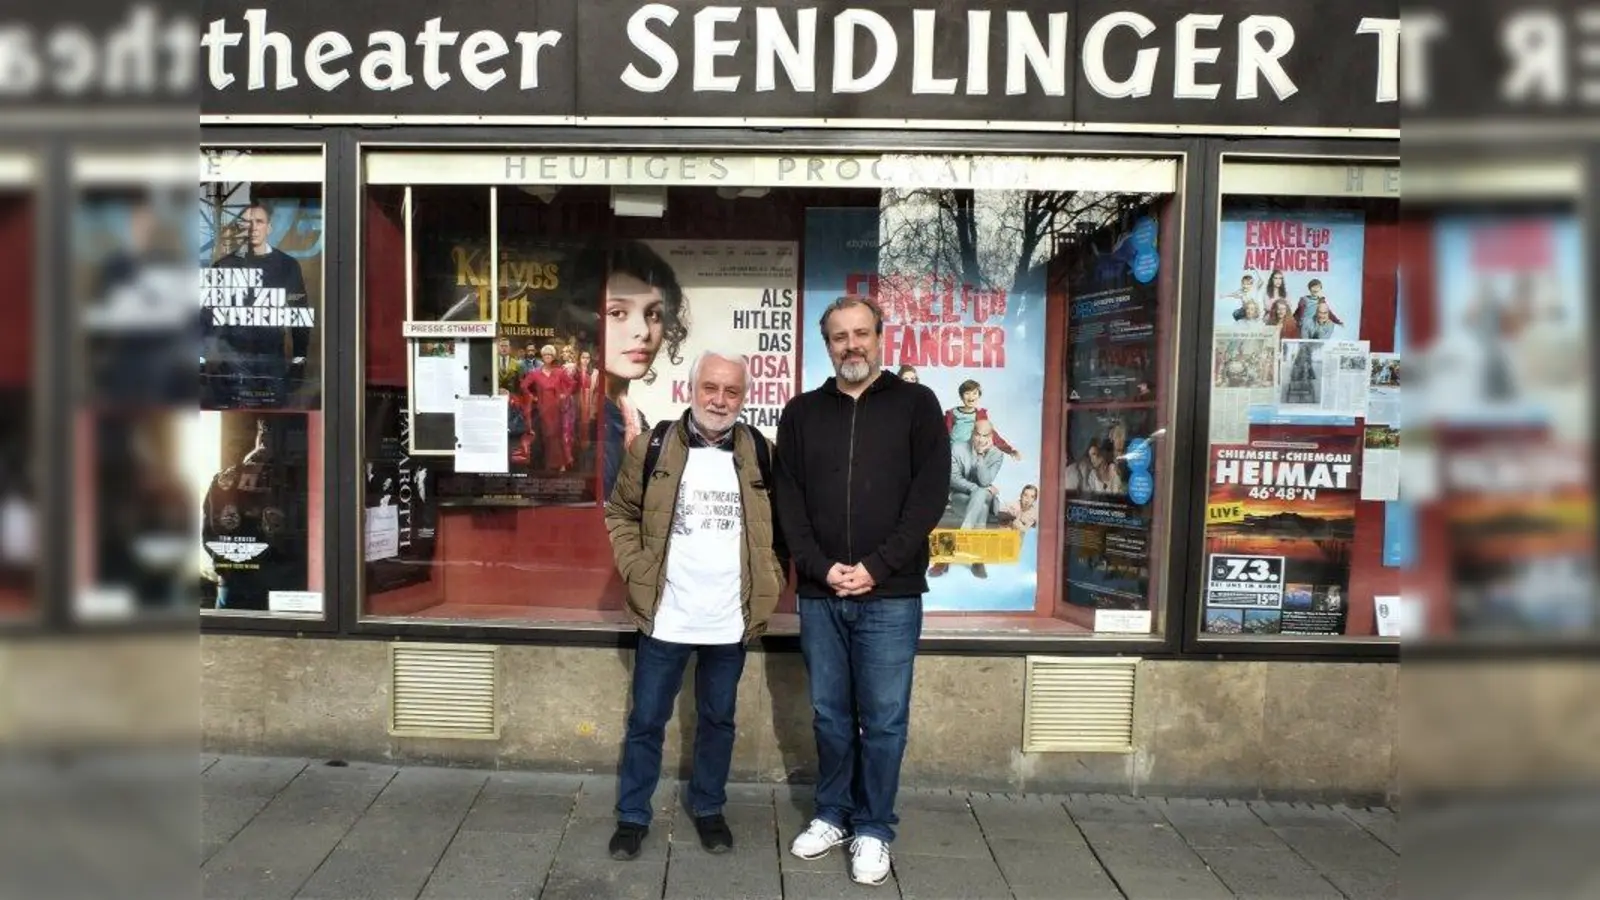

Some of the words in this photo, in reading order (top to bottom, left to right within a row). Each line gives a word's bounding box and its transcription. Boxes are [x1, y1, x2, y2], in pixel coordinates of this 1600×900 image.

[201, 9, 562, 91] theater
[620, 3, 1299, 101] SENDLINGER
[504, 156, 729, 180] HEUTIGES
[1246, 219, 1306, 248] ENKEL
[1306, 227, 1330, 247] FÜR
[1244, 247, 1329, 272] ANFÄNGER
[200, 268, 263, 287] KEINE
[200, 288, 248, 306] ZEIT
[252, 288, 286, 306] ZU
[761, 289, 792, 308] ALS
[212, 307, 314, 327] STERBEN
[733, 310, 792, 330] HITLER
[411, 324, 488, 333] PRESSE-STIMMEN
[758, 333, 792, 351] DAS
[1217, 450, 1279, 460] CHIEMSEE
[1286, 452, 1352, 463] CHIEMGAU
[1216, 460, 1352, 489] HEIMAT
[1210, 507, 1240, 518] LIVE
[1226, 559, 1279, 581] 7.3.
